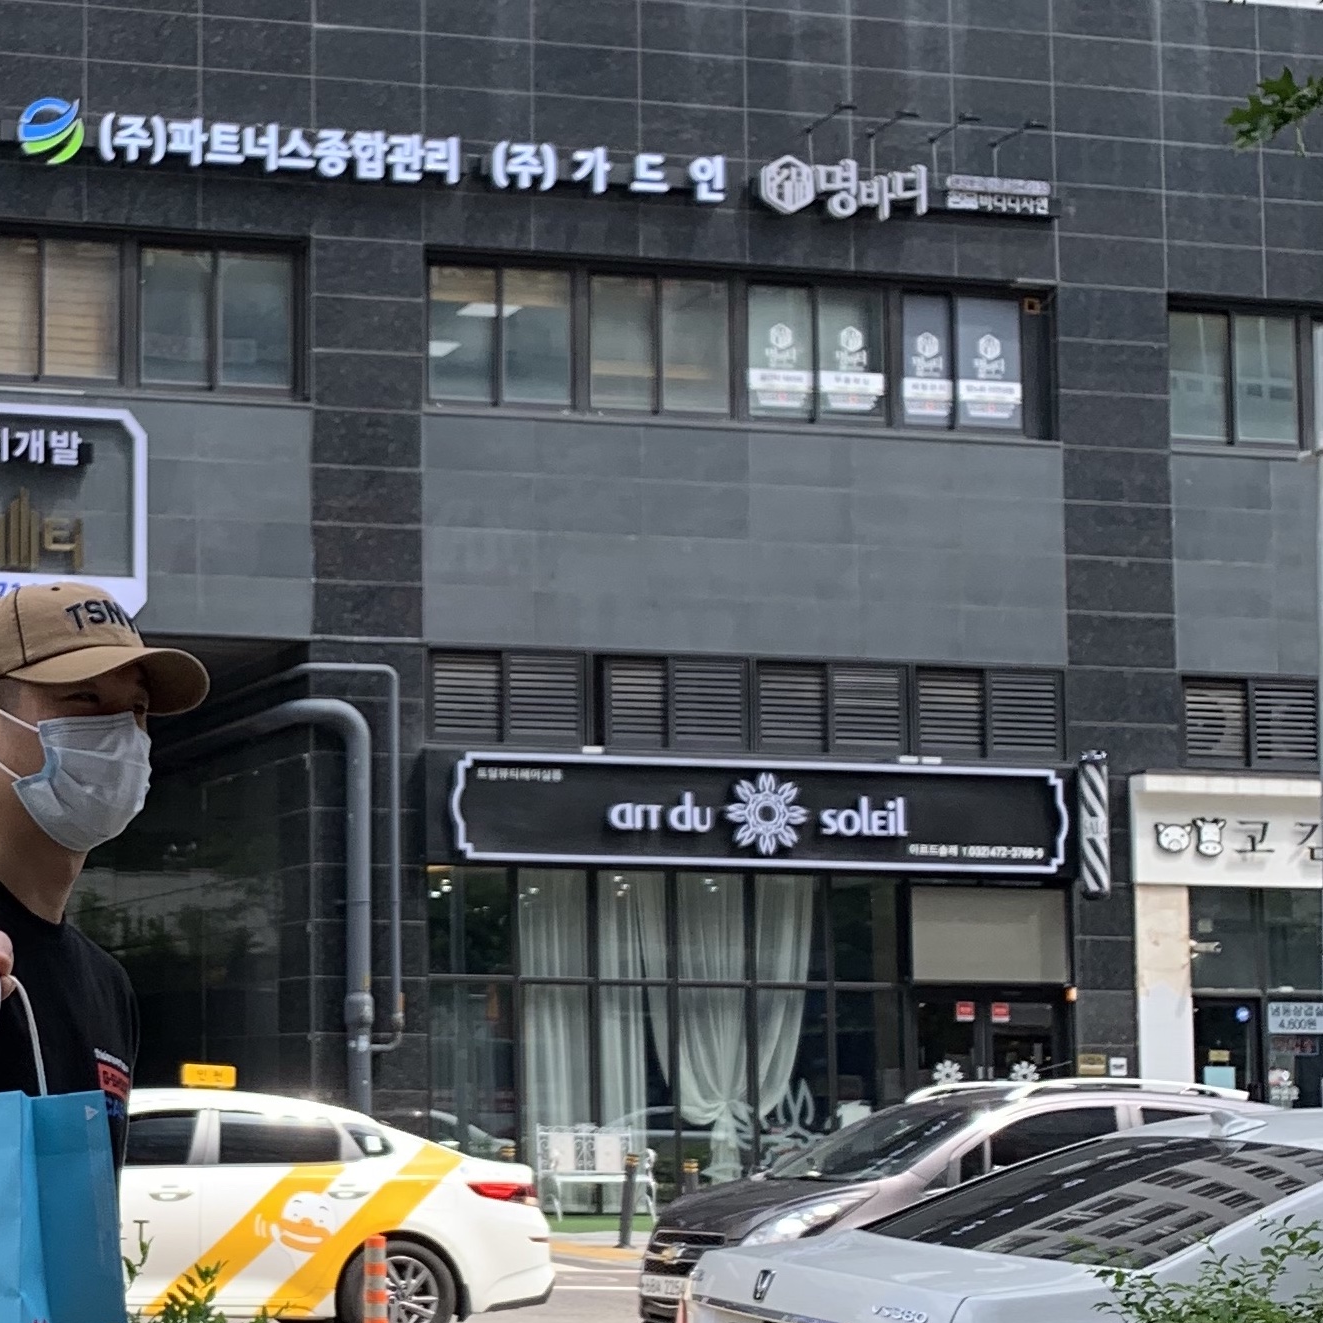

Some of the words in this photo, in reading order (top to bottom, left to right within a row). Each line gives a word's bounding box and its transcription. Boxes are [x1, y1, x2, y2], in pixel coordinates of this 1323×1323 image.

[814, 158, 928, 221] 명바디
[667, 791, 713, 833] du
[819, 796, 909, 838] soleil
